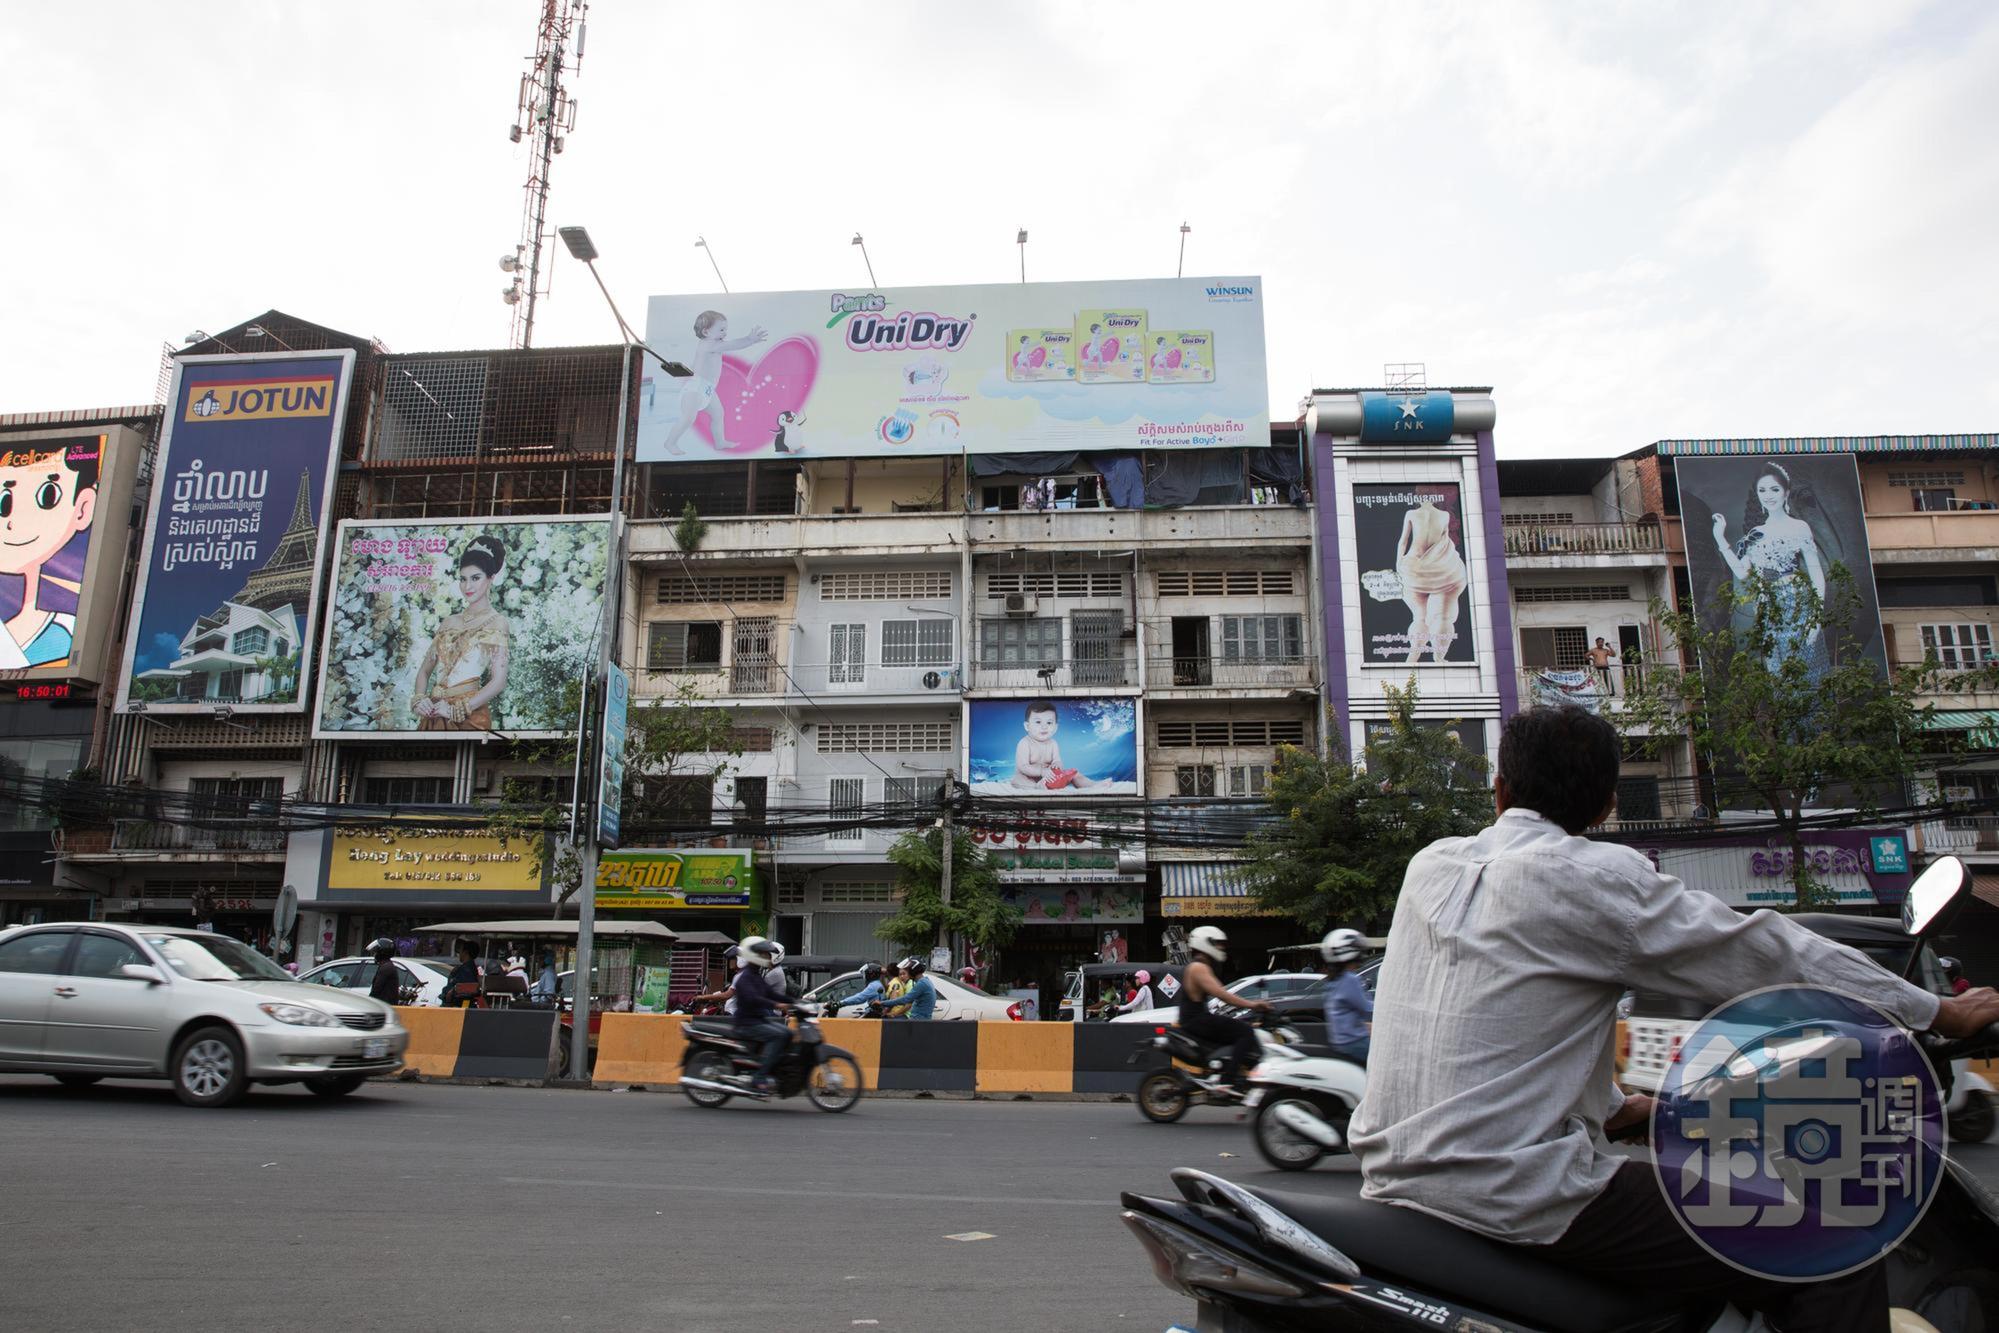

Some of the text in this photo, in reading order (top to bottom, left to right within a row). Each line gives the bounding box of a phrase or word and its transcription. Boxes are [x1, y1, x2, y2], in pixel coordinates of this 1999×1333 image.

[1206, 287, 1252, 295] WINSUN
[223, 385, 327, 415] JOTUN
[1393, 420, 1424, 430] SNK
[1153, 437, 1165, 445] For
[17, 685, 70, 698] 16:50:01
[1878, 855, 1903, 863] SNK
[1377, 1287, 1450, 1317] Smash
